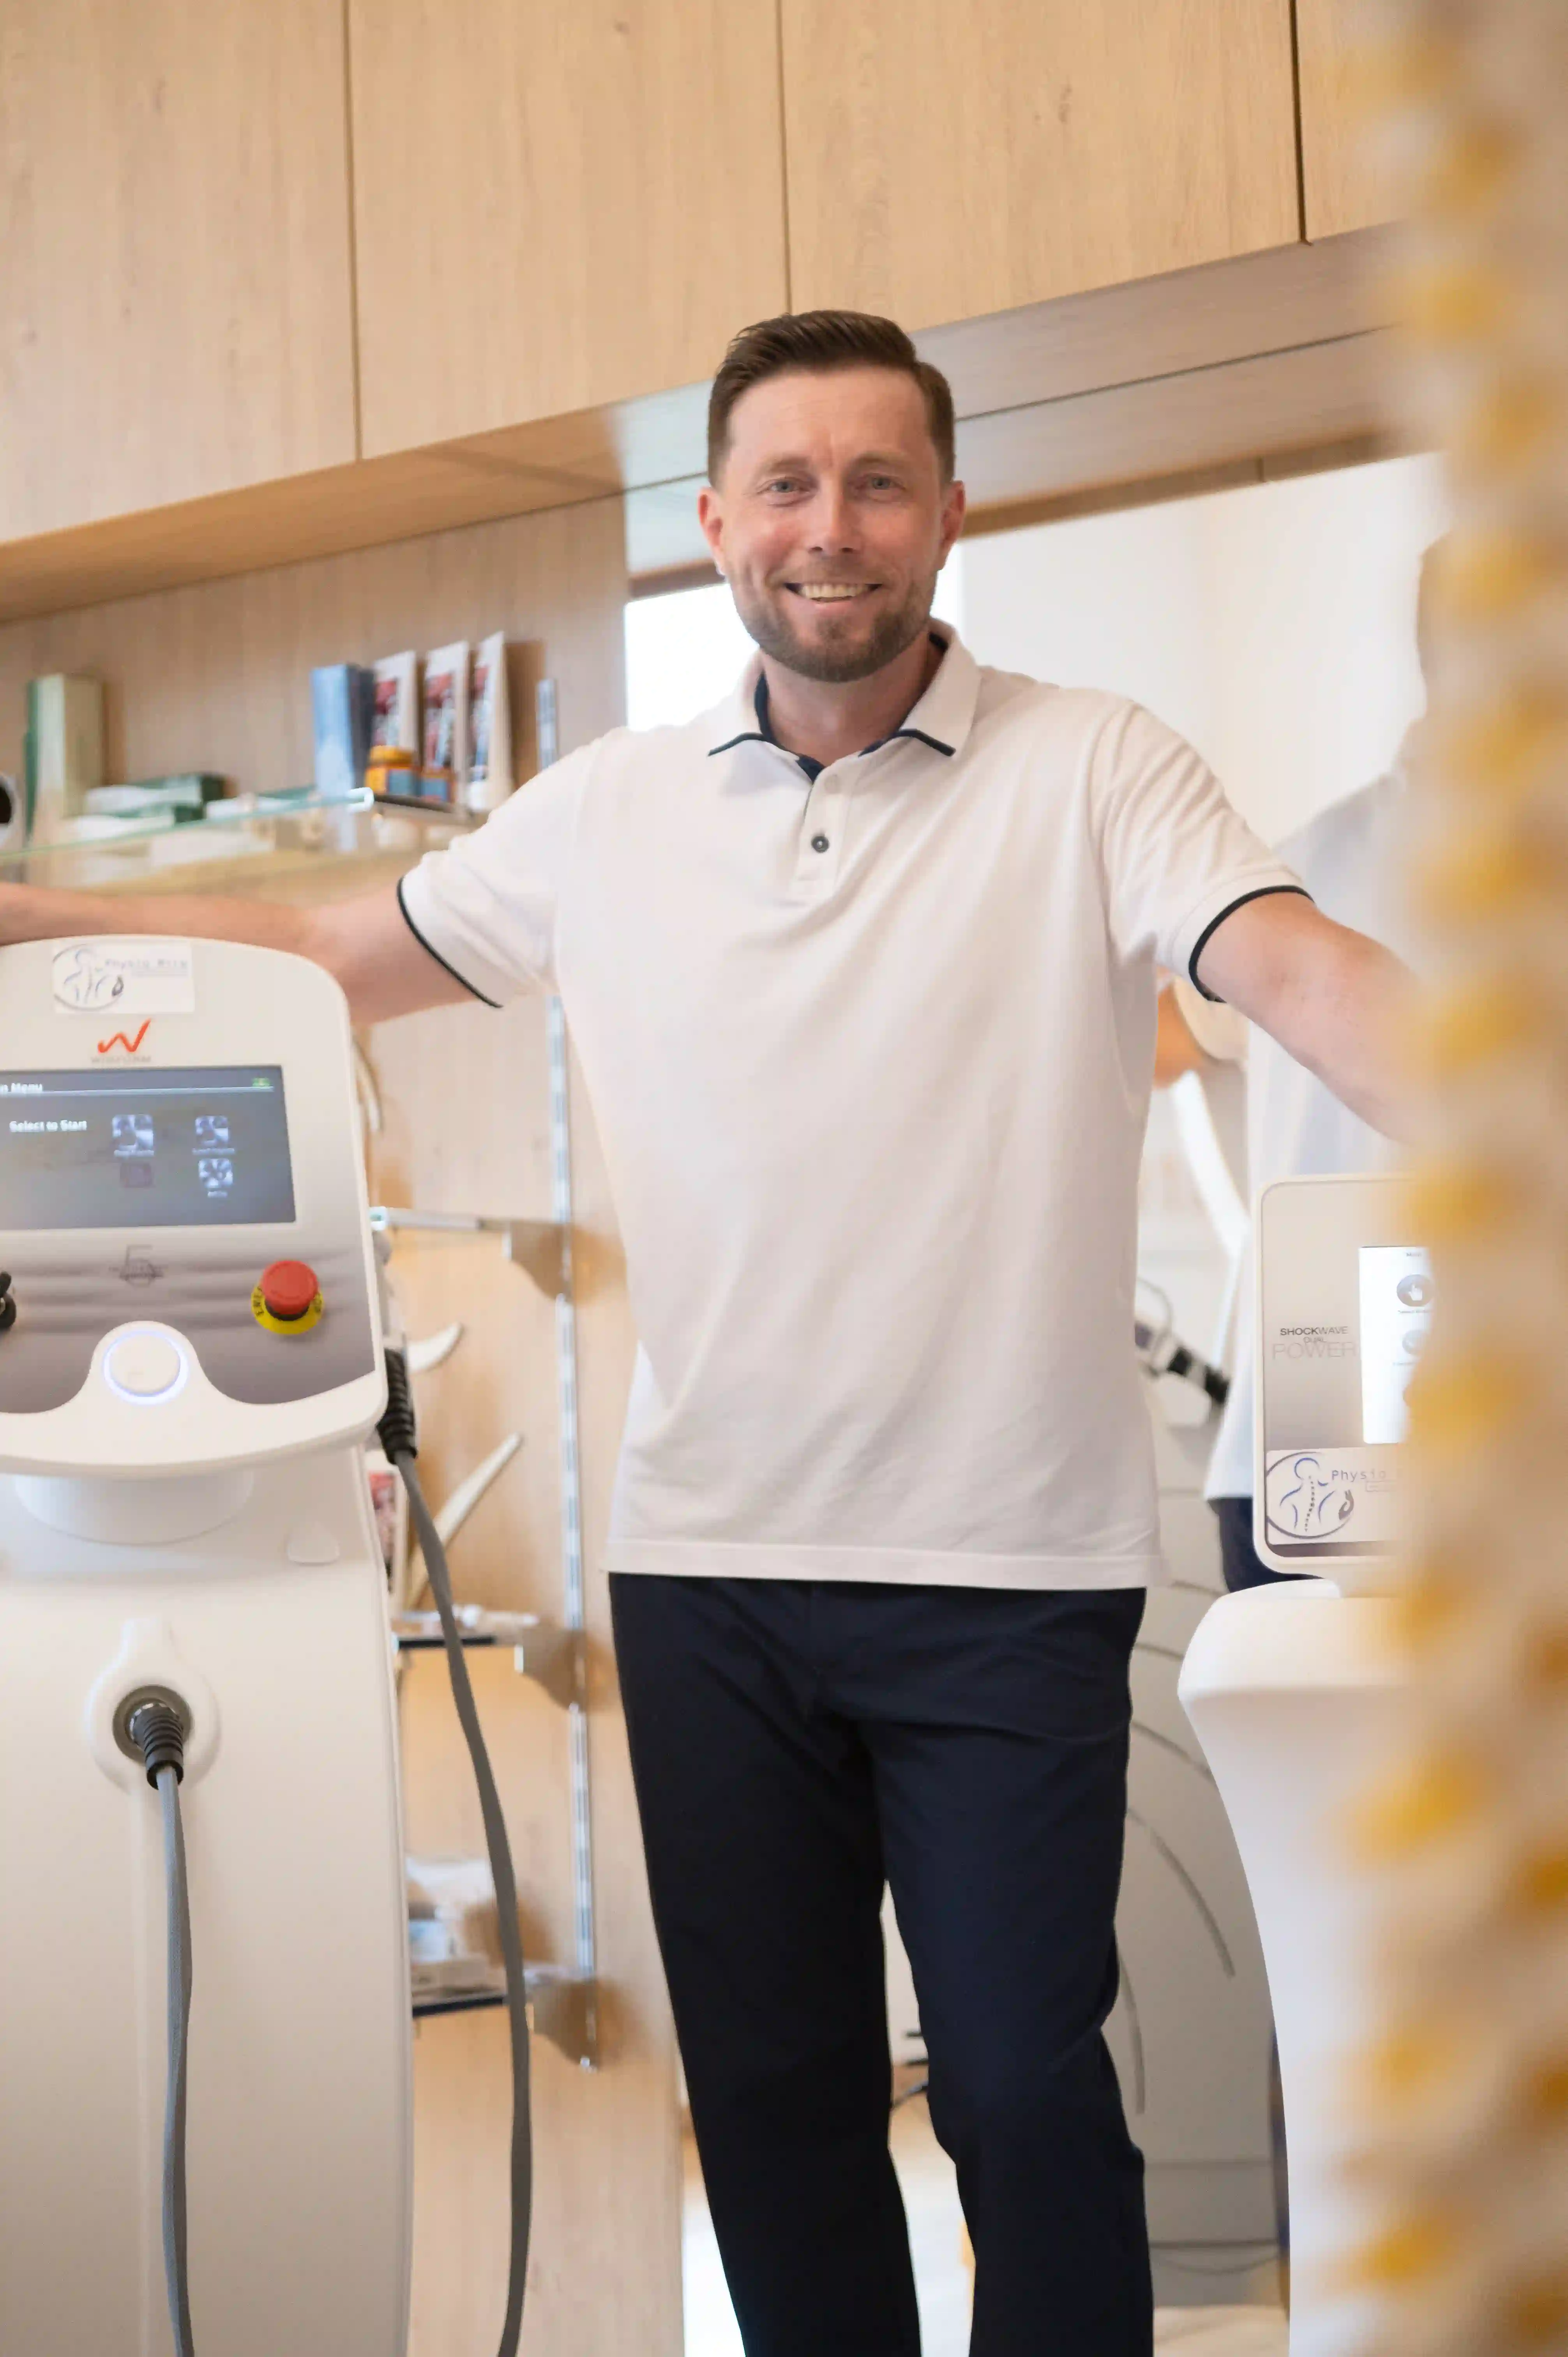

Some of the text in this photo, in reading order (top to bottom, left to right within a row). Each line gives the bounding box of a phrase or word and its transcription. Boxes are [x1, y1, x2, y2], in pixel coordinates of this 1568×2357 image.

[9, 1119, 87, 1132] Select to Start
[1280, 1326, 1348, 1336] SHOCKWAVE
[1272, 1341, 1356, 1360] POWER
[1332, 1468, 1386, 1482] Physio
